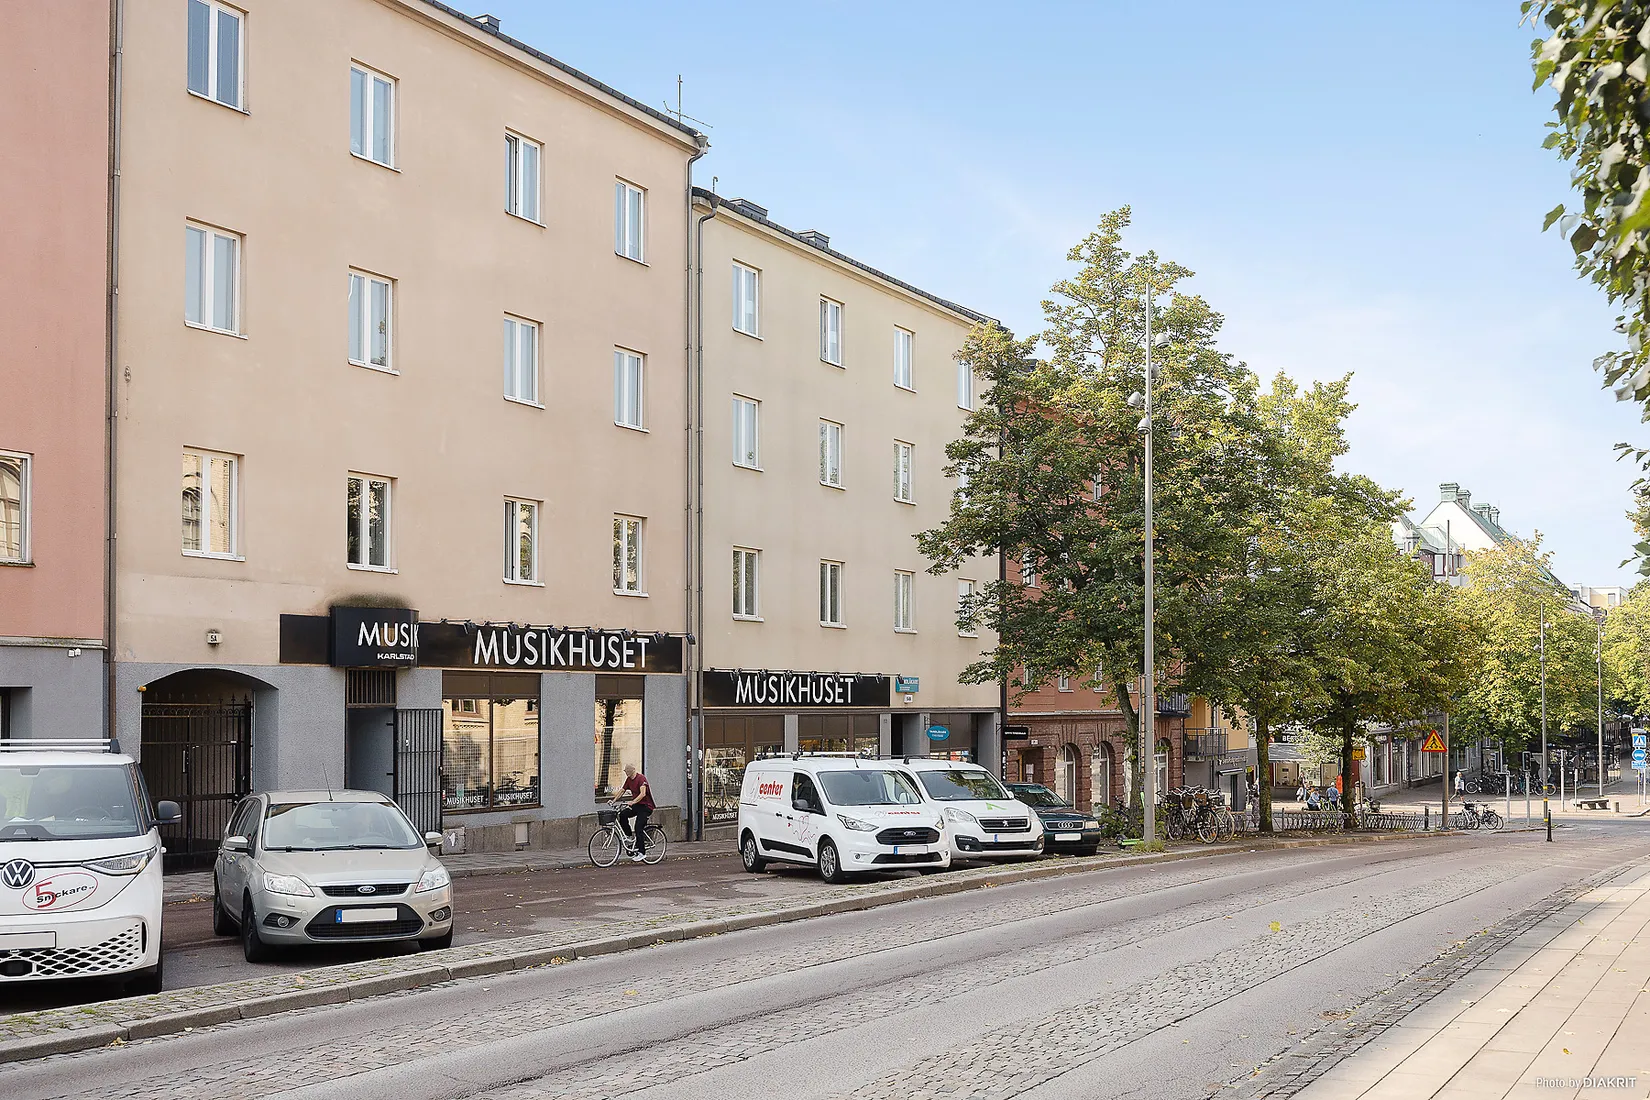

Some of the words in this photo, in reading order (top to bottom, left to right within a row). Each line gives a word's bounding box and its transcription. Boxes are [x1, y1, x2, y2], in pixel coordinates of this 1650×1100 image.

[358, 621, 420, 648] MUSIK
[473, 629, 650, 668] MUSIKHUSET
[735, 675, 854, 704] MUSIKHUSET
[446, 795, 485, 805] MUSIKHUSET
[759, 780, 783, 796] center
